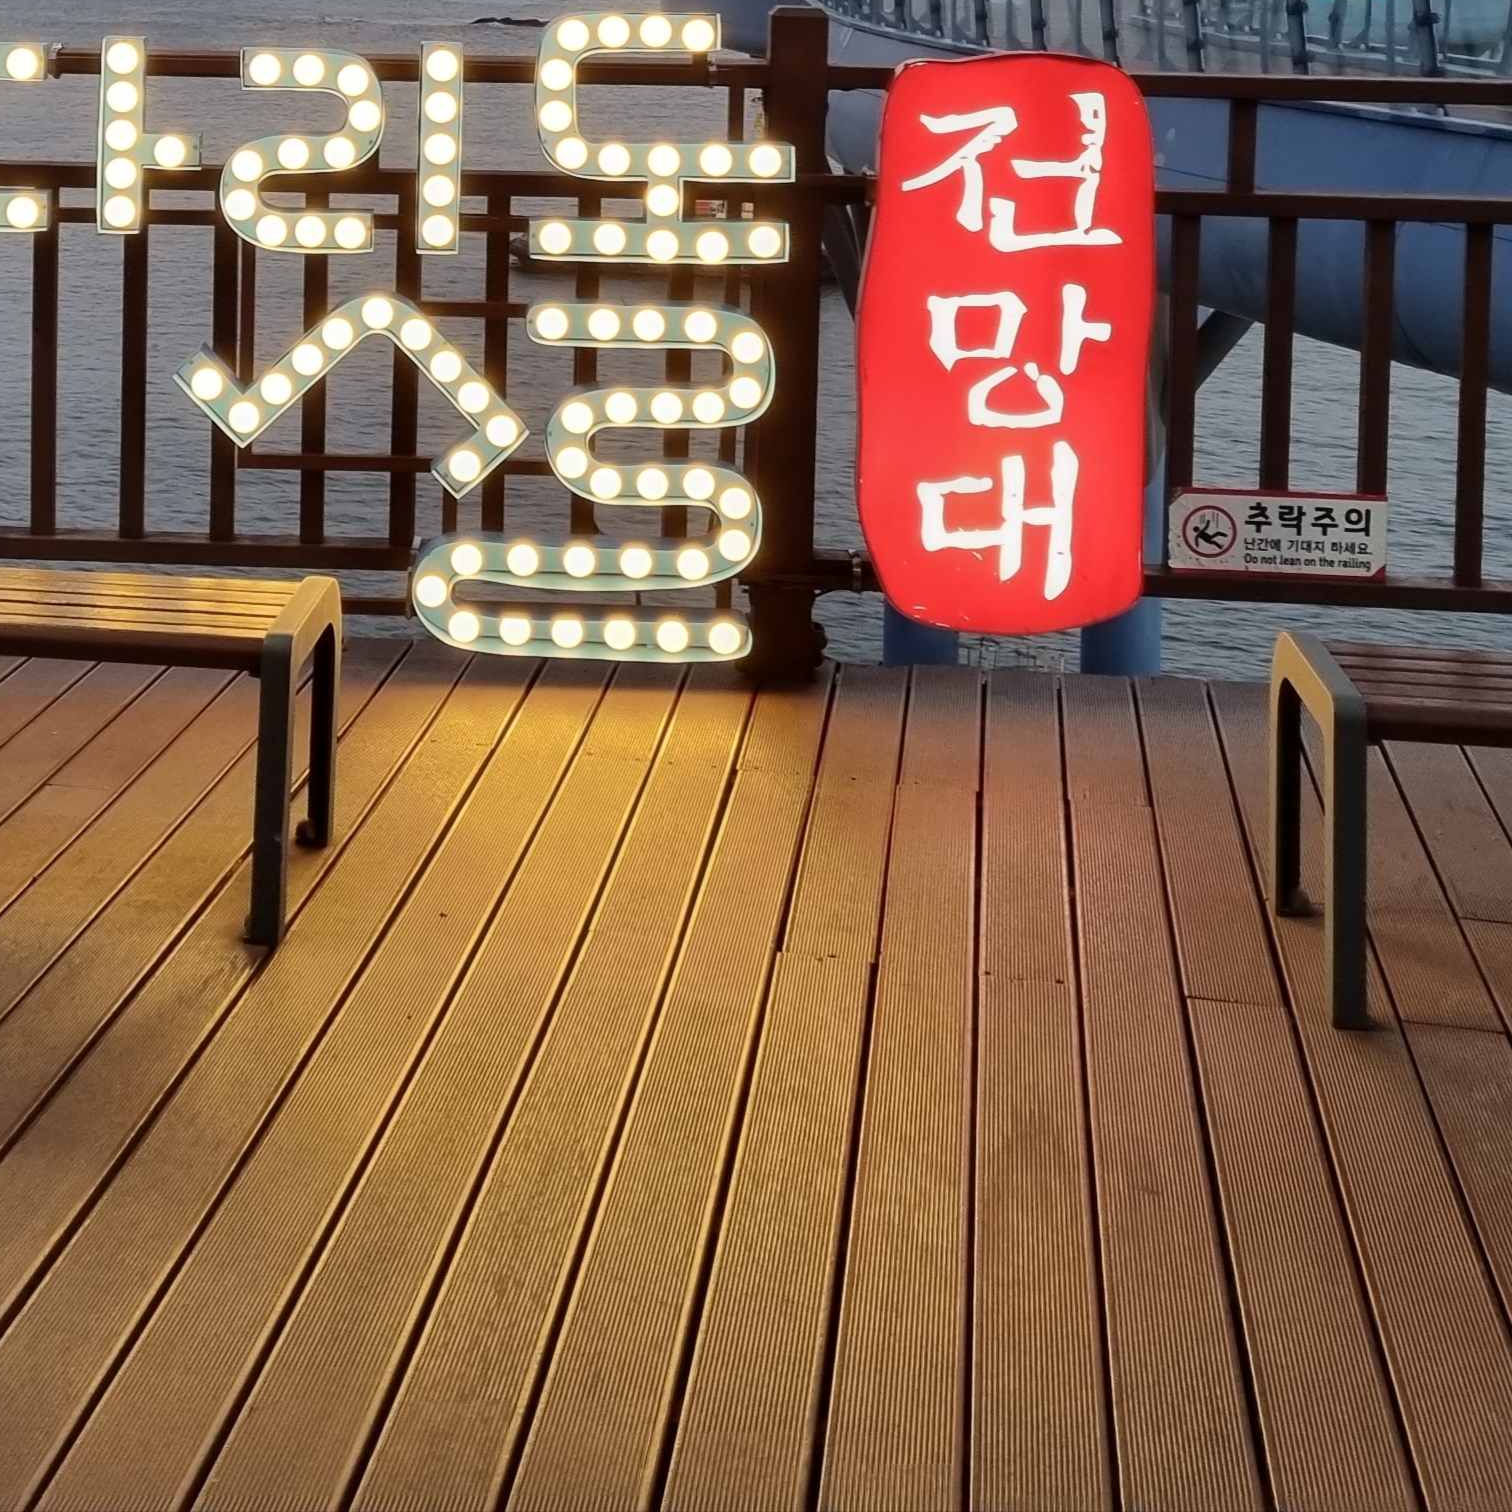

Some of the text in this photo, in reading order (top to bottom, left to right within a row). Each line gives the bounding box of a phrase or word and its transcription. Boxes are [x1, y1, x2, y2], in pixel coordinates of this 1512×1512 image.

[901, 91, 1123, 601] 전망대
[1244, 501, 1371, 537] 추락주의
[1244, 537, 1281, 551] 난간에
[1287, 539, 1325, 553] 기대지
[1244, 553, 1371, 572] Do not lean on the railing
